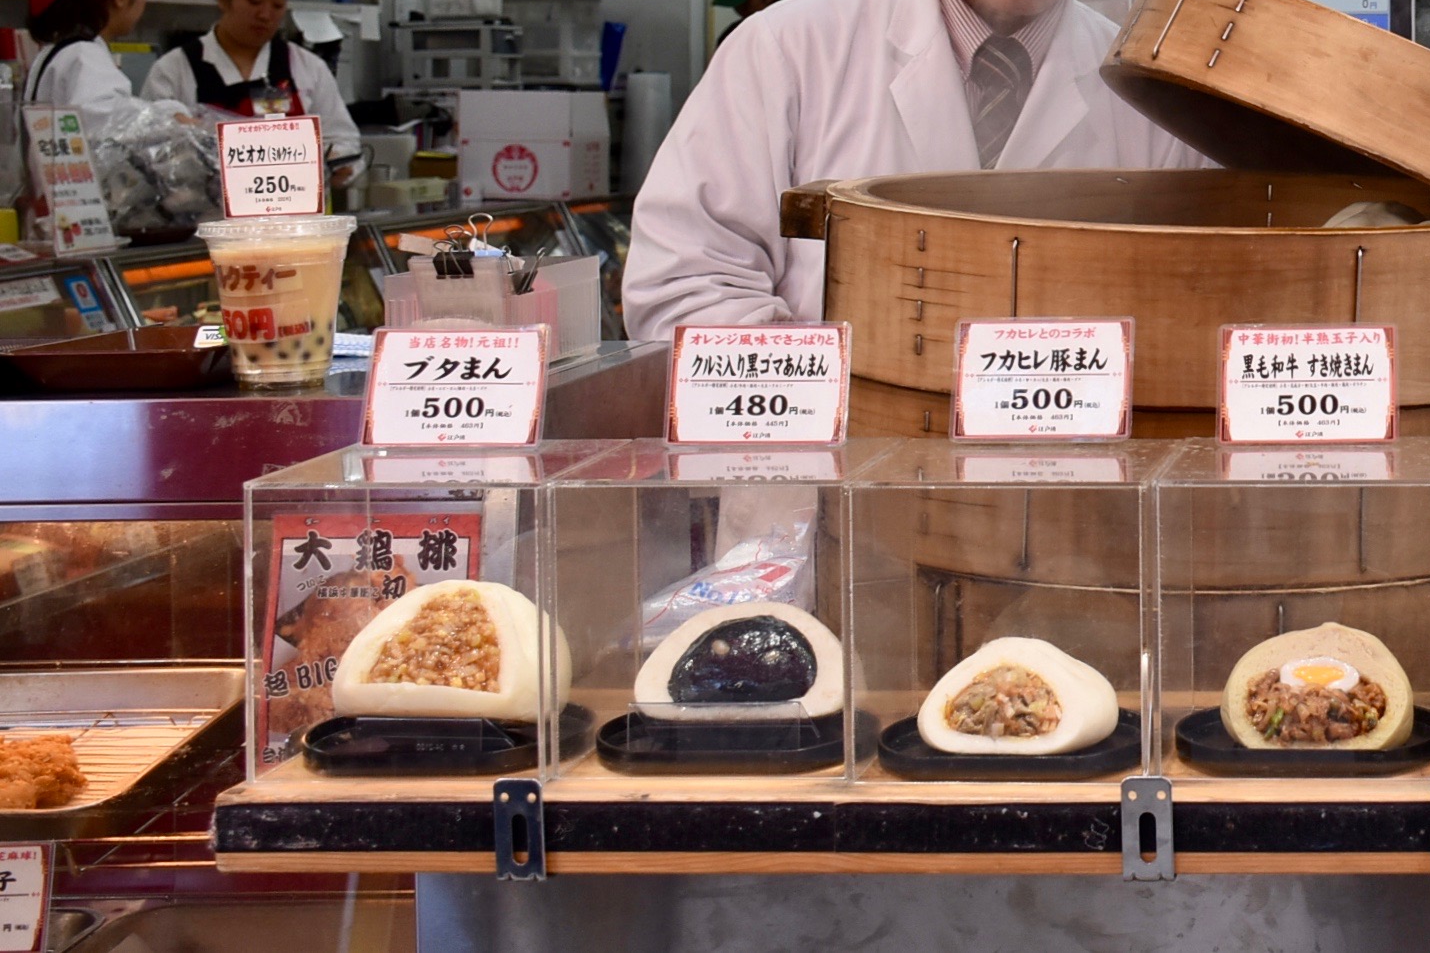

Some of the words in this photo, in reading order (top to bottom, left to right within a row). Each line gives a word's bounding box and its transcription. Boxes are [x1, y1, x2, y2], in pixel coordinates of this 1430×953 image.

[690, 333, 835, 346] オレンジ風味でさっぱりと
[994, 326, 1096, 339] フカヒレとのコラボ
[404, 355, 513, 381] ブタまん
[691, 352, 830, 379] クルミ入り黒ゴマあんまん
[980, 347, 1109, 372] フカヒレ豚まん
[1242, 353, 1299, 379] 黒毛和牛
[1307, 353, 1374, 379] すき焼きまん
